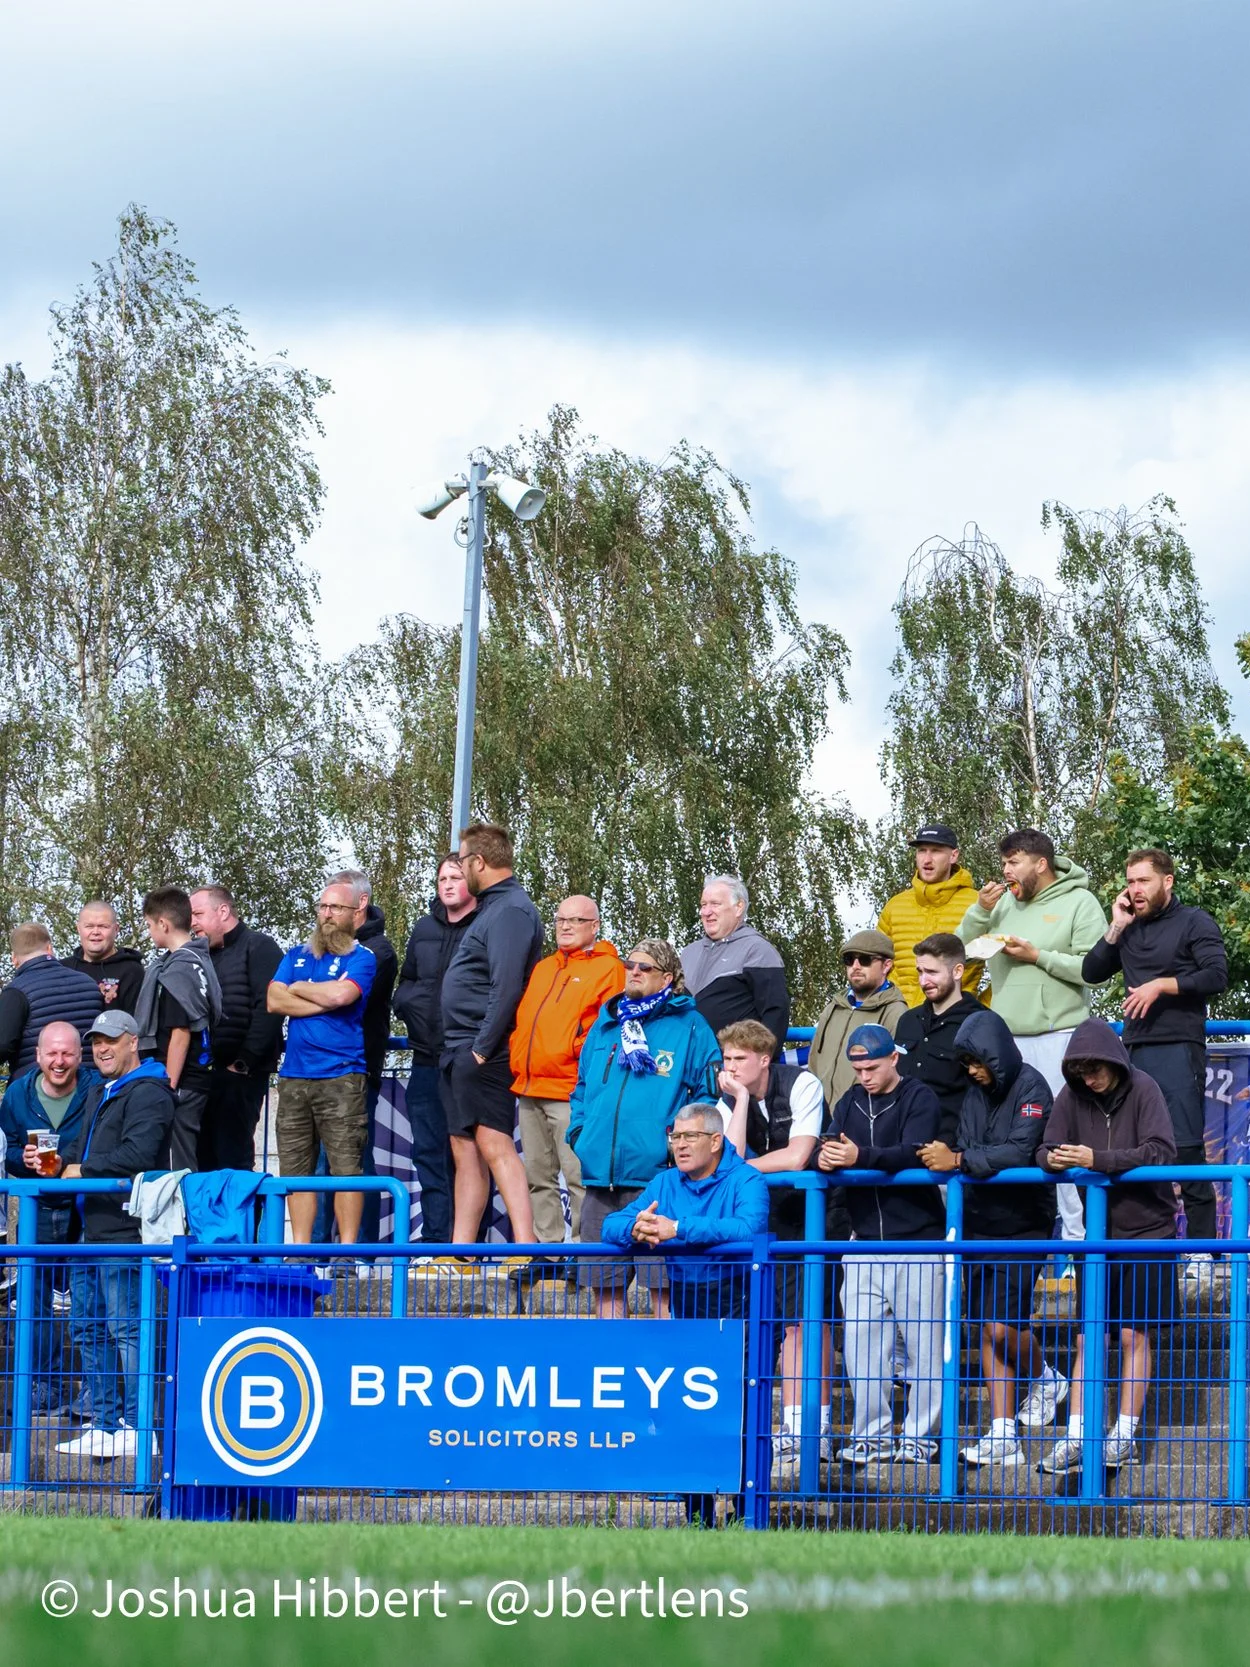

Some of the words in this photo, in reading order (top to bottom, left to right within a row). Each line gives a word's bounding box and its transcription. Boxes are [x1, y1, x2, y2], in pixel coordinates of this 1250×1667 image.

[241, 1376, 285, 1429] B
[350, 1365, 719, 1410] BROMLEYS
[428, 1430, 578, 1448] SOLICITORS
[589, 1431, 636, 1448] LLP
